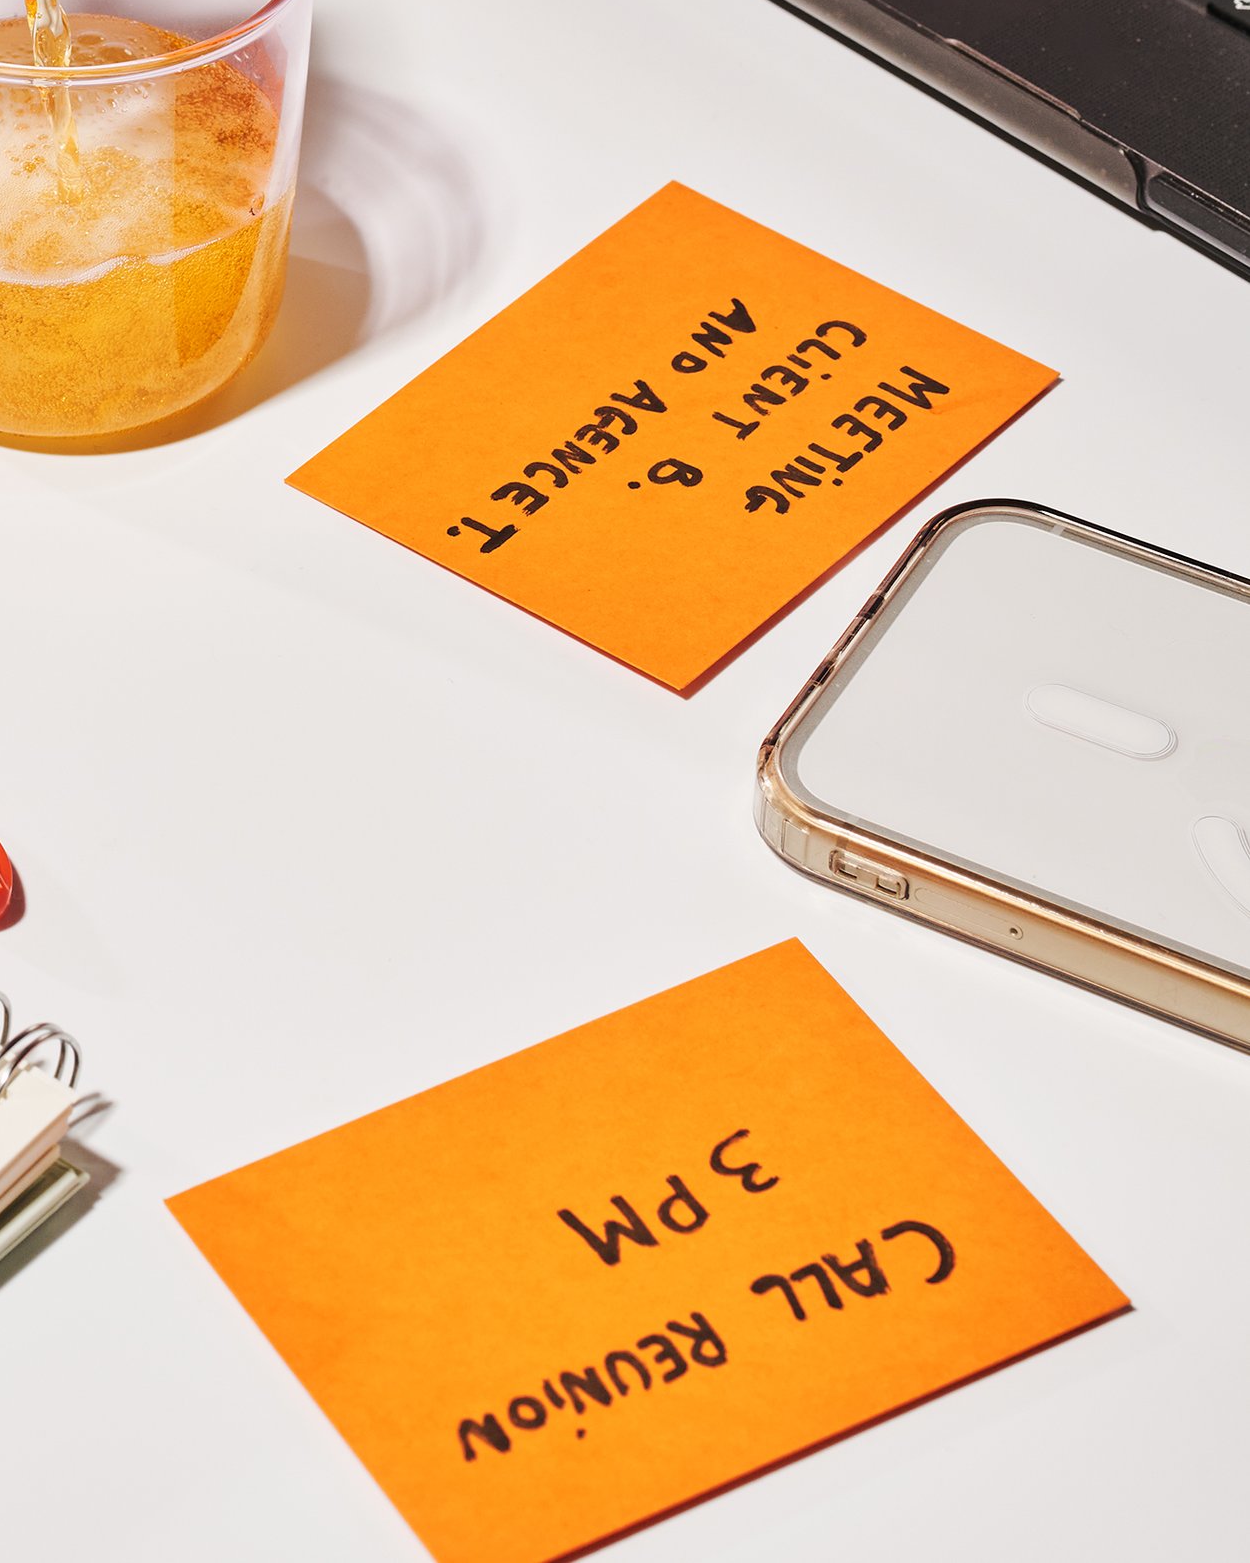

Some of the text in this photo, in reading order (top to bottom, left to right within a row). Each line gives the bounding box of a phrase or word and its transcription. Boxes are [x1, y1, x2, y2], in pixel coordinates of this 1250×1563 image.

[447, 298, 757, 554] AND AGENCE T.
[627, 458, 703, 490] B.
[557, 1129, 780, 1266] 3 PM
[751, 1221, 955, 1321] CALL
